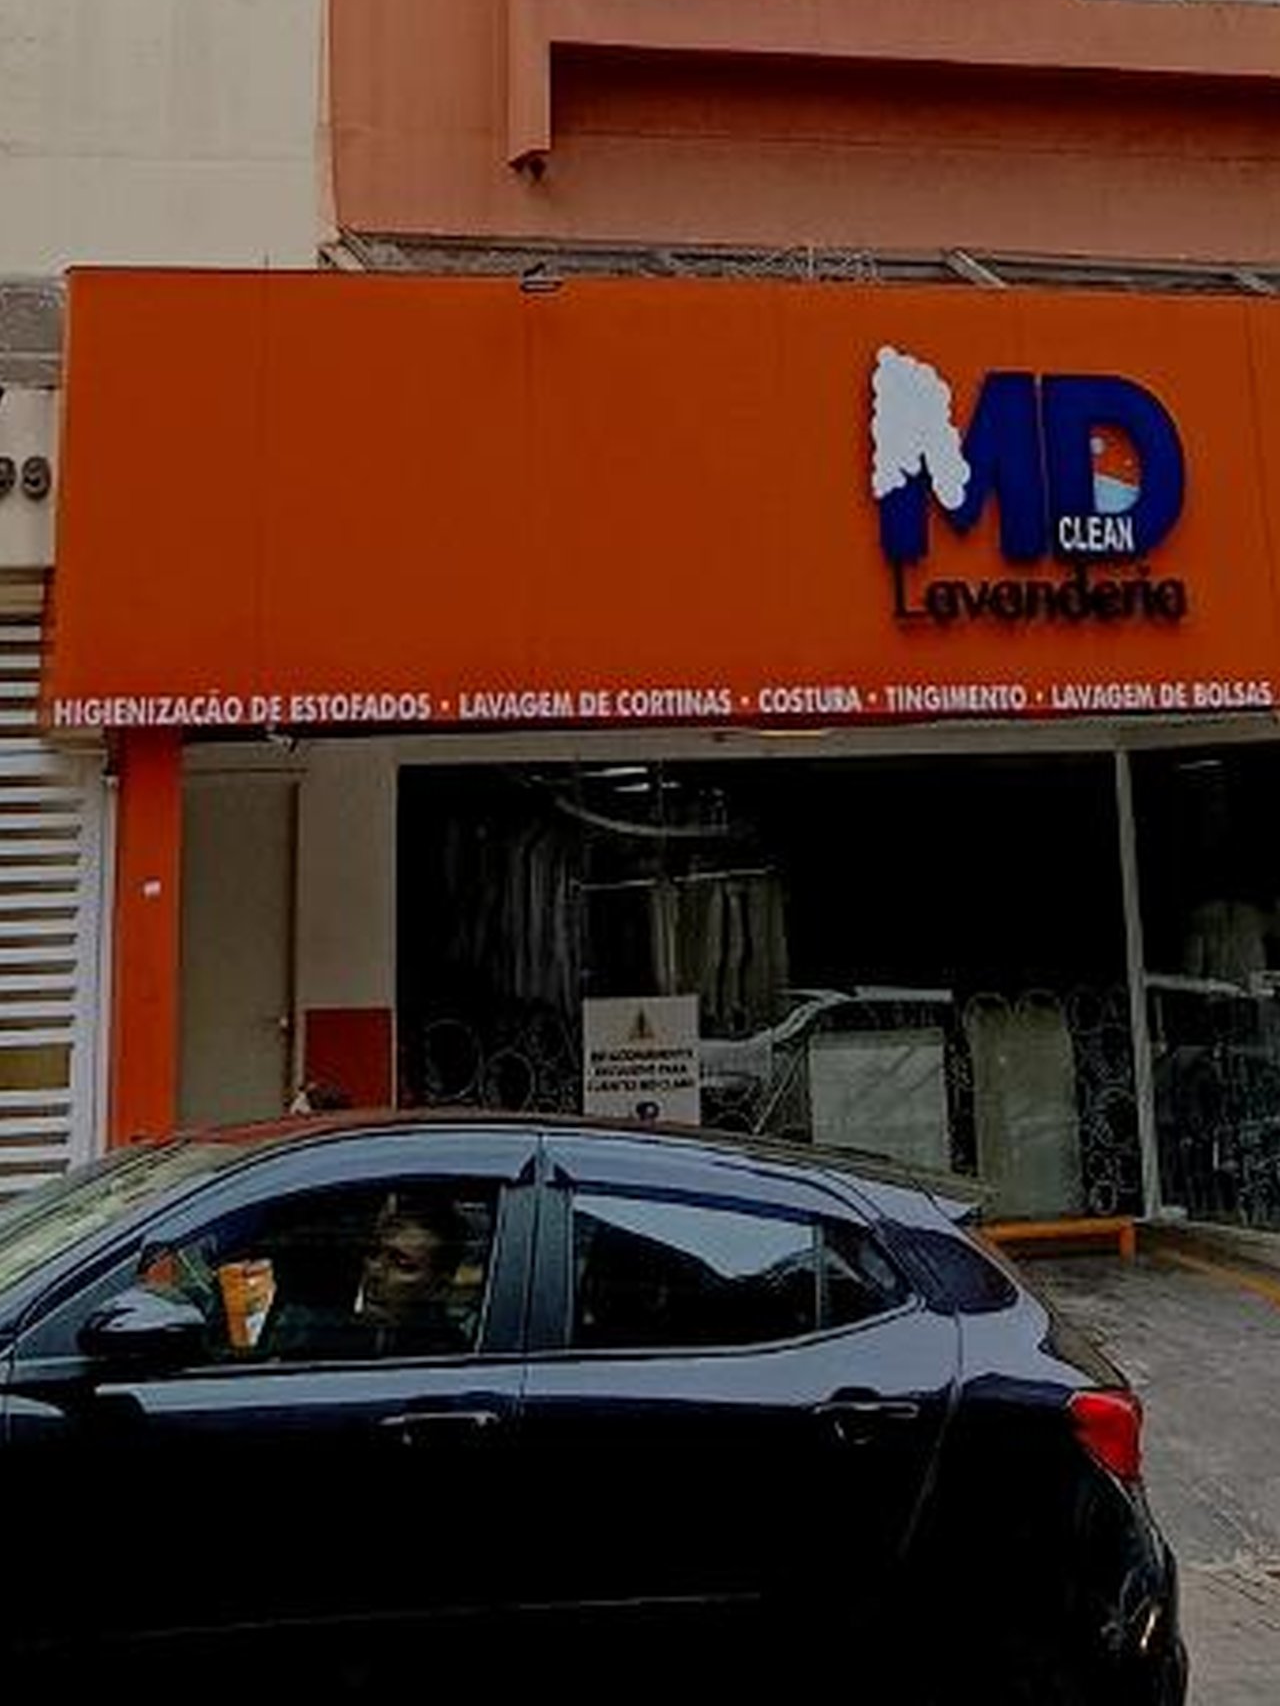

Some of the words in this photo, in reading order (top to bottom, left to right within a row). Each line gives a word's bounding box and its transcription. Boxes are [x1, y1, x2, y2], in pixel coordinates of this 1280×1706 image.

[870, 345, 1186, 565] MD
[1058, 515, 1136, 552] CLEAN
[892, 559, 1188, 623] Lavanderia
[251, 694, 282, 724] DE
[289, 692, 432, 721] ESTOFADOS
[458, 691, 574, 720] LAVAGEM
[579, 691, 612, 718] DE
[616, 688, 732, 717] CORTINAS
[758, 686, 862, 713] COSTURA
[884, 684, 1028, 712] TINGIMENTO
[1050, 683, 1155, 710] LAVAGEM
[1159, 682, 1188, 708] DE
[1193, 681, 1274, 708] BOLSAS
